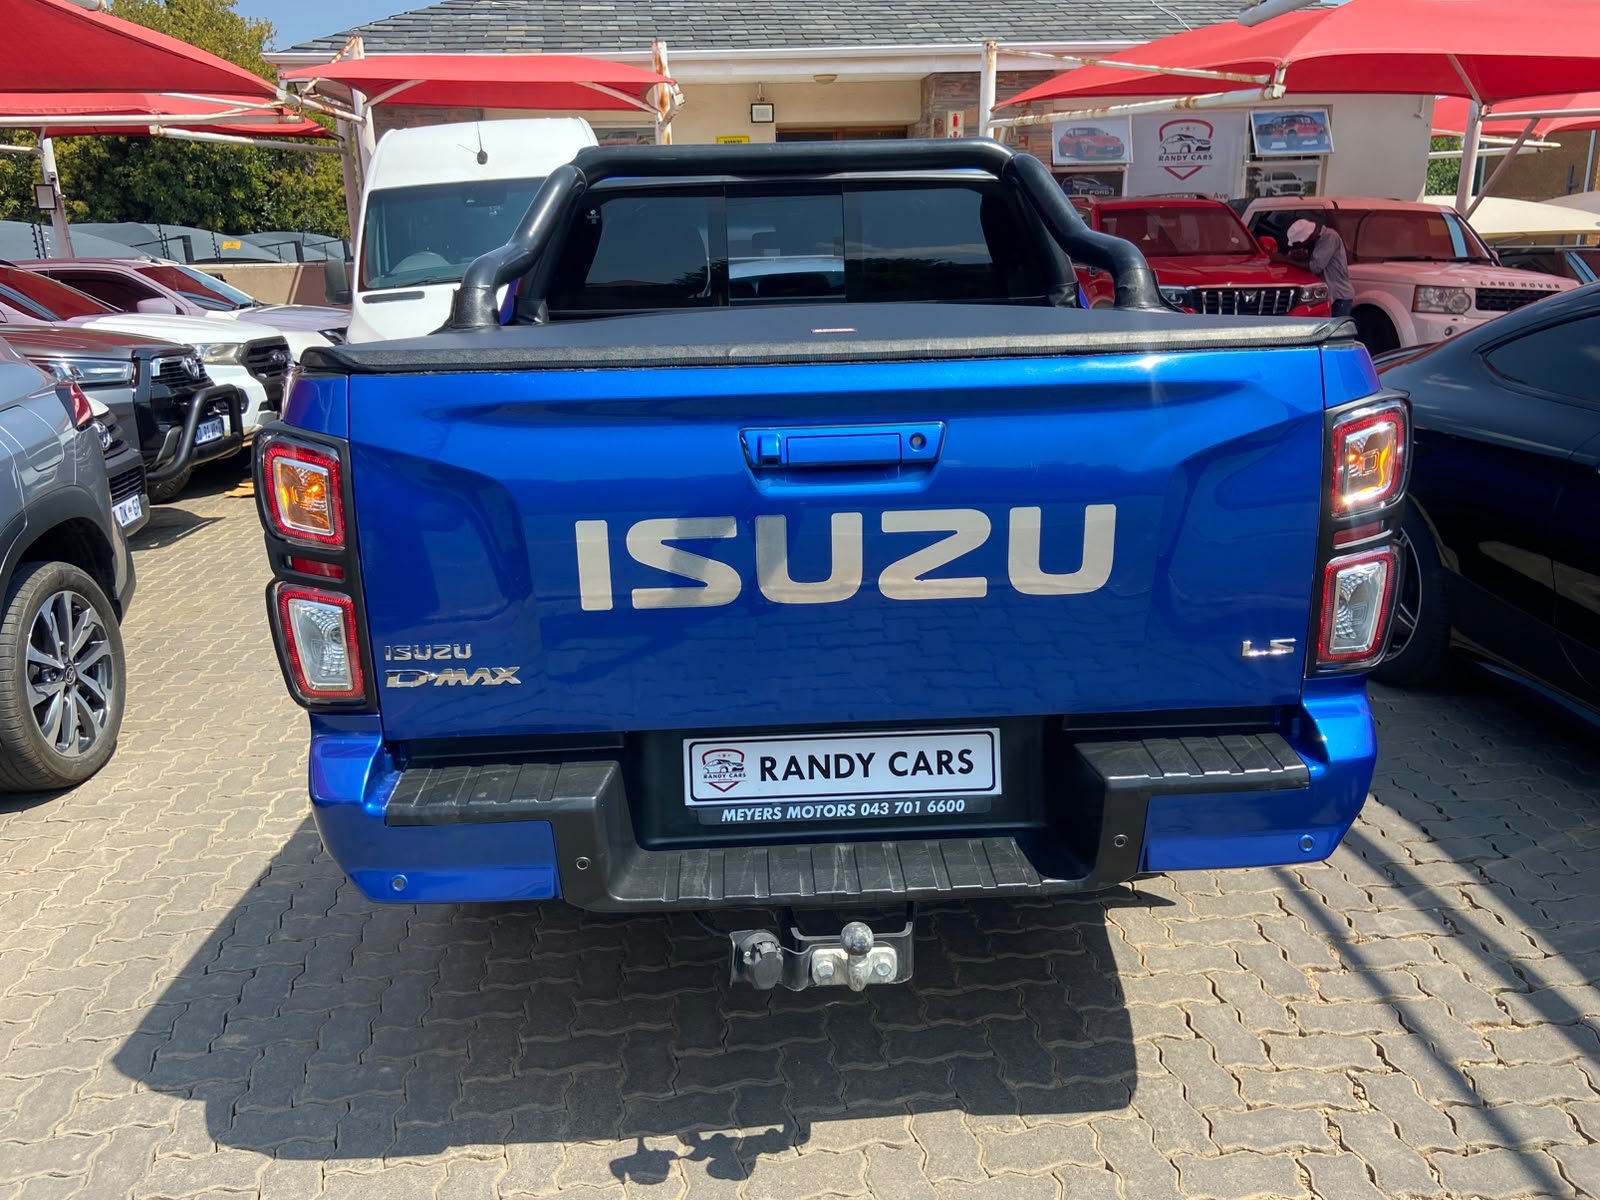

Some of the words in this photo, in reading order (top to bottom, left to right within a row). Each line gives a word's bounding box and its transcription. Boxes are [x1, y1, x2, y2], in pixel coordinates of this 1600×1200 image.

[575, 504, 1117, 611] ISUZU
[384, 643, 472, 661] ISUZU
[1241, 638, 1296, 657] LS
[759, 753, 876, 782] RANDY
[888, 749, 974, 777] CARS
[721, 807, 782, 822] MEYERS
[786, 804, 856, 820] MOTORS
[861, 802, 889, 816] 043
[894, 801, 921, 815] 701
[927, 799, 965, 814] 6600
